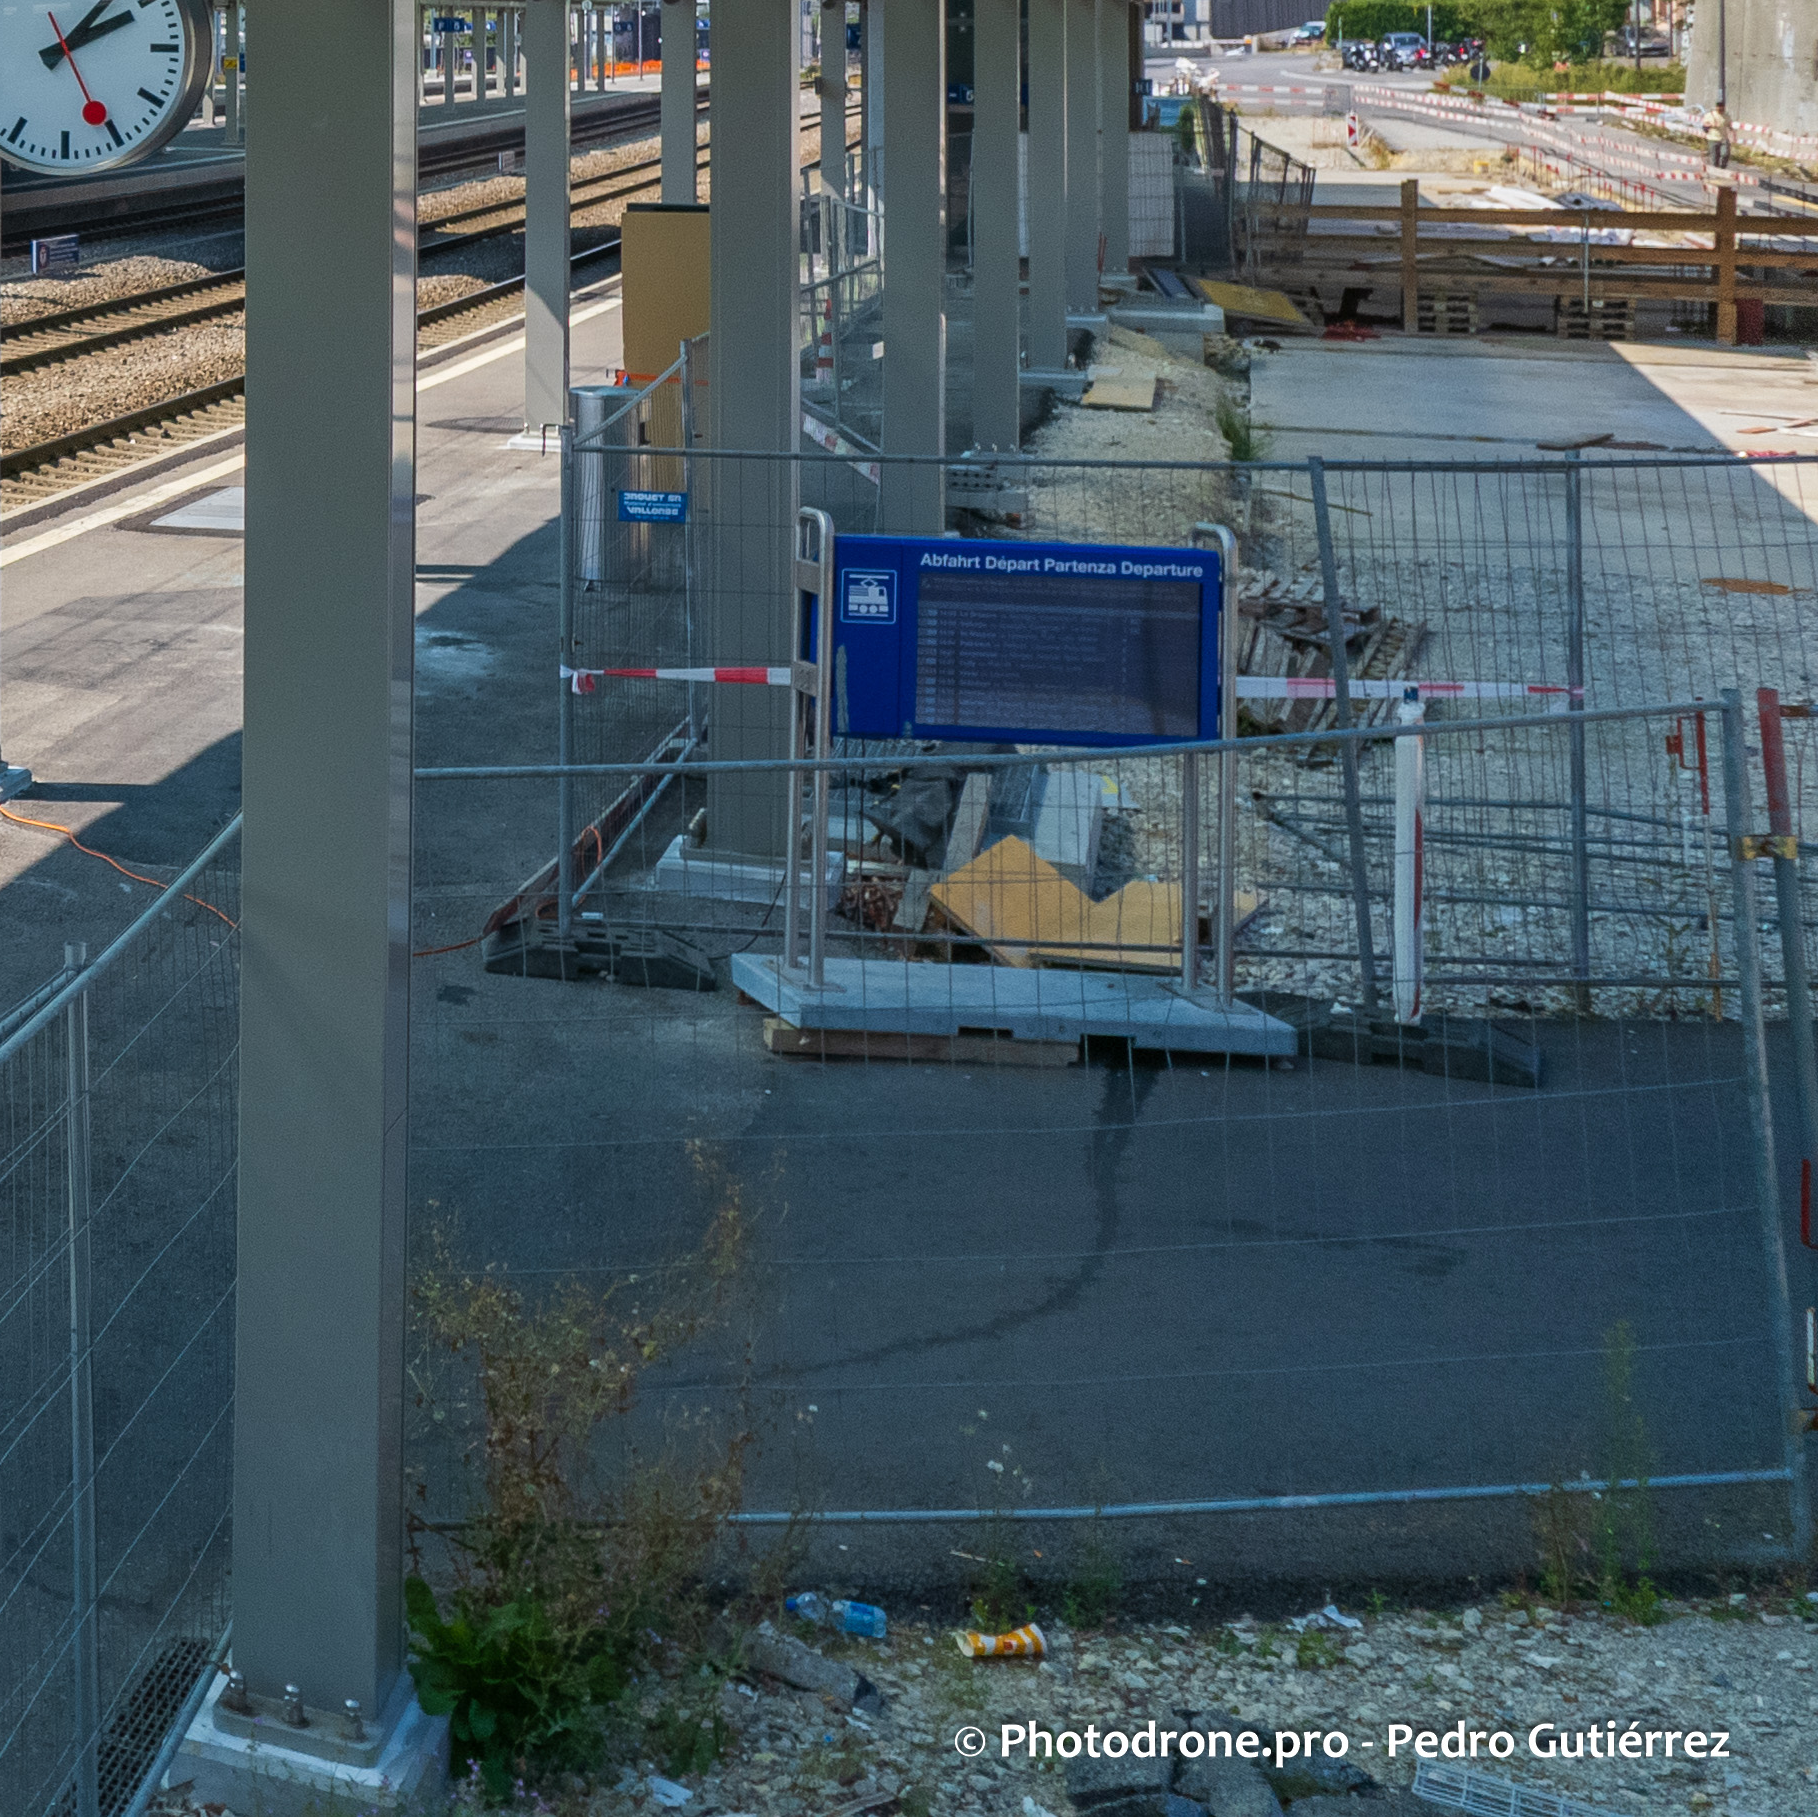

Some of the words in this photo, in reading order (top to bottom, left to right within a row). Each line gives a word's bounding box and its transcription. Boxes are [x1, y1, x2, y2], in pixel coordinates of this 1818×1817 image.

[920, 552, 981, 569] Abfahrt
[985, 555, 1040, 573] Départ
[1044, 558, 1116, 574] Partenza
[1121, 561, 1203, 578] Departure
